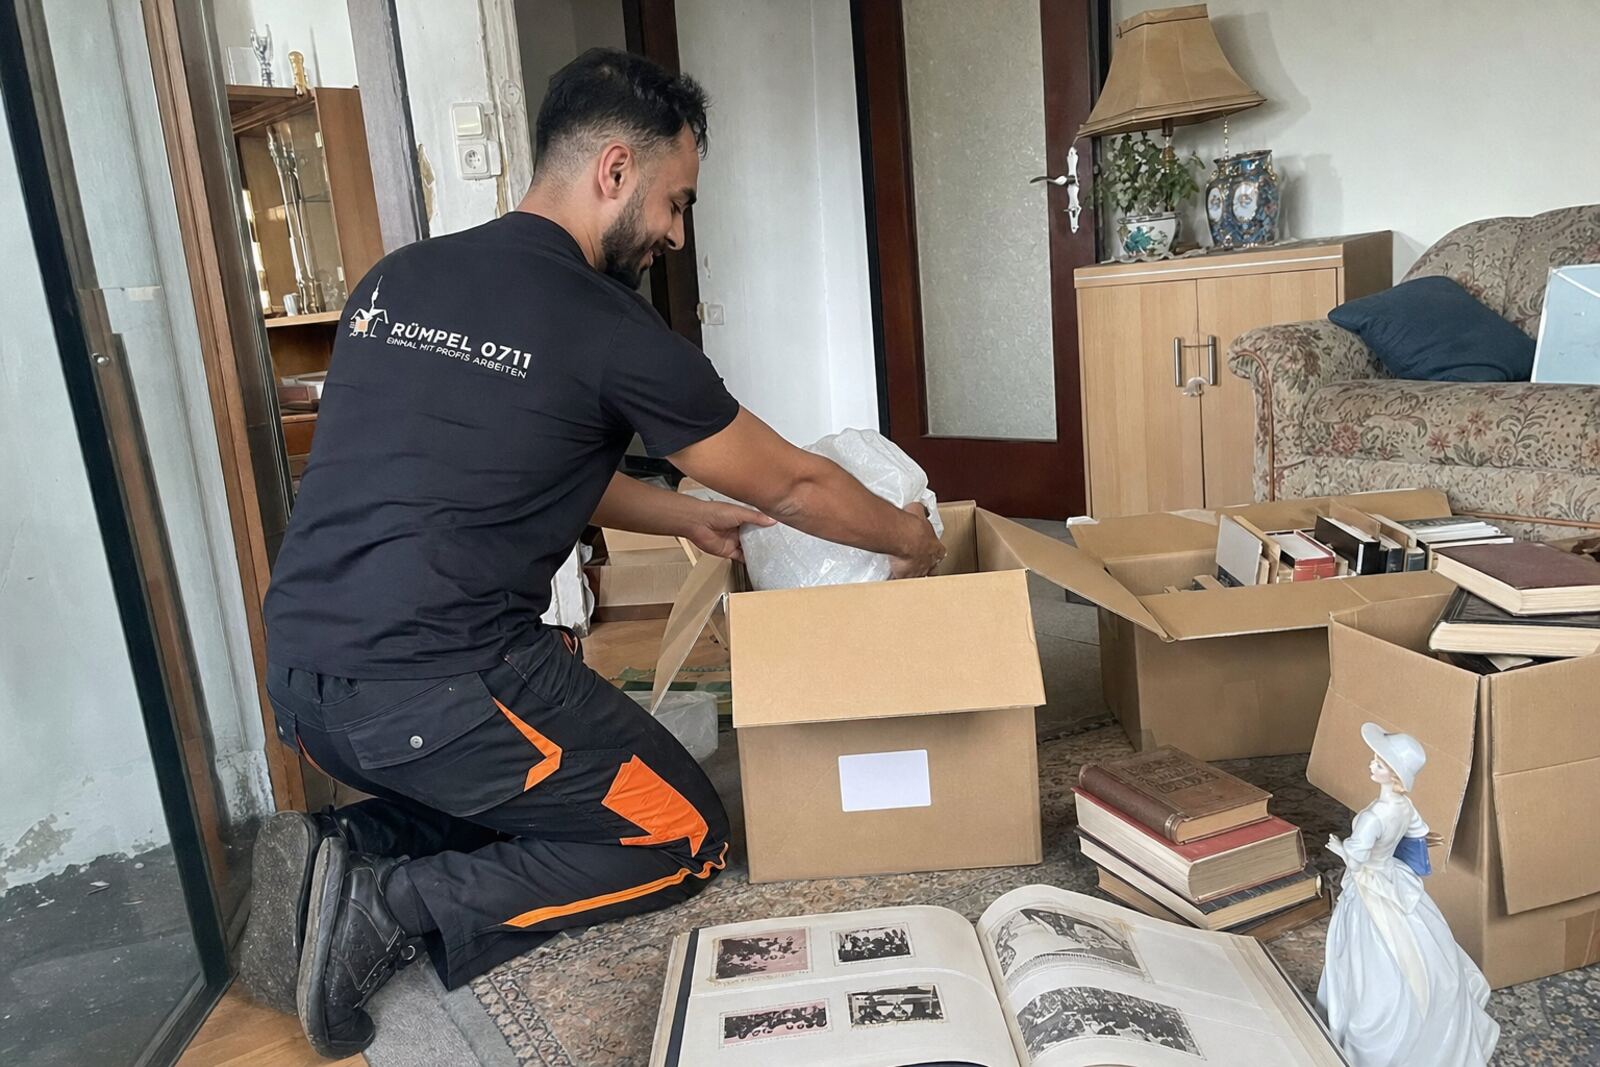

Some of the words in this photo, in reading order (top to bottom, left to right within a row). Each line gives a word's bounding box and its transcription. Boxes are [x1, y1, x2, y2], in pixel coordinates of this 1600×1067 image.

[391, 322, 472, 352] RÜMPEL
[480, 341, 532, 370] 0711
[435, 346, 471, 362] PROFIS
[472, 357, 527, 379] ARBEITEN
